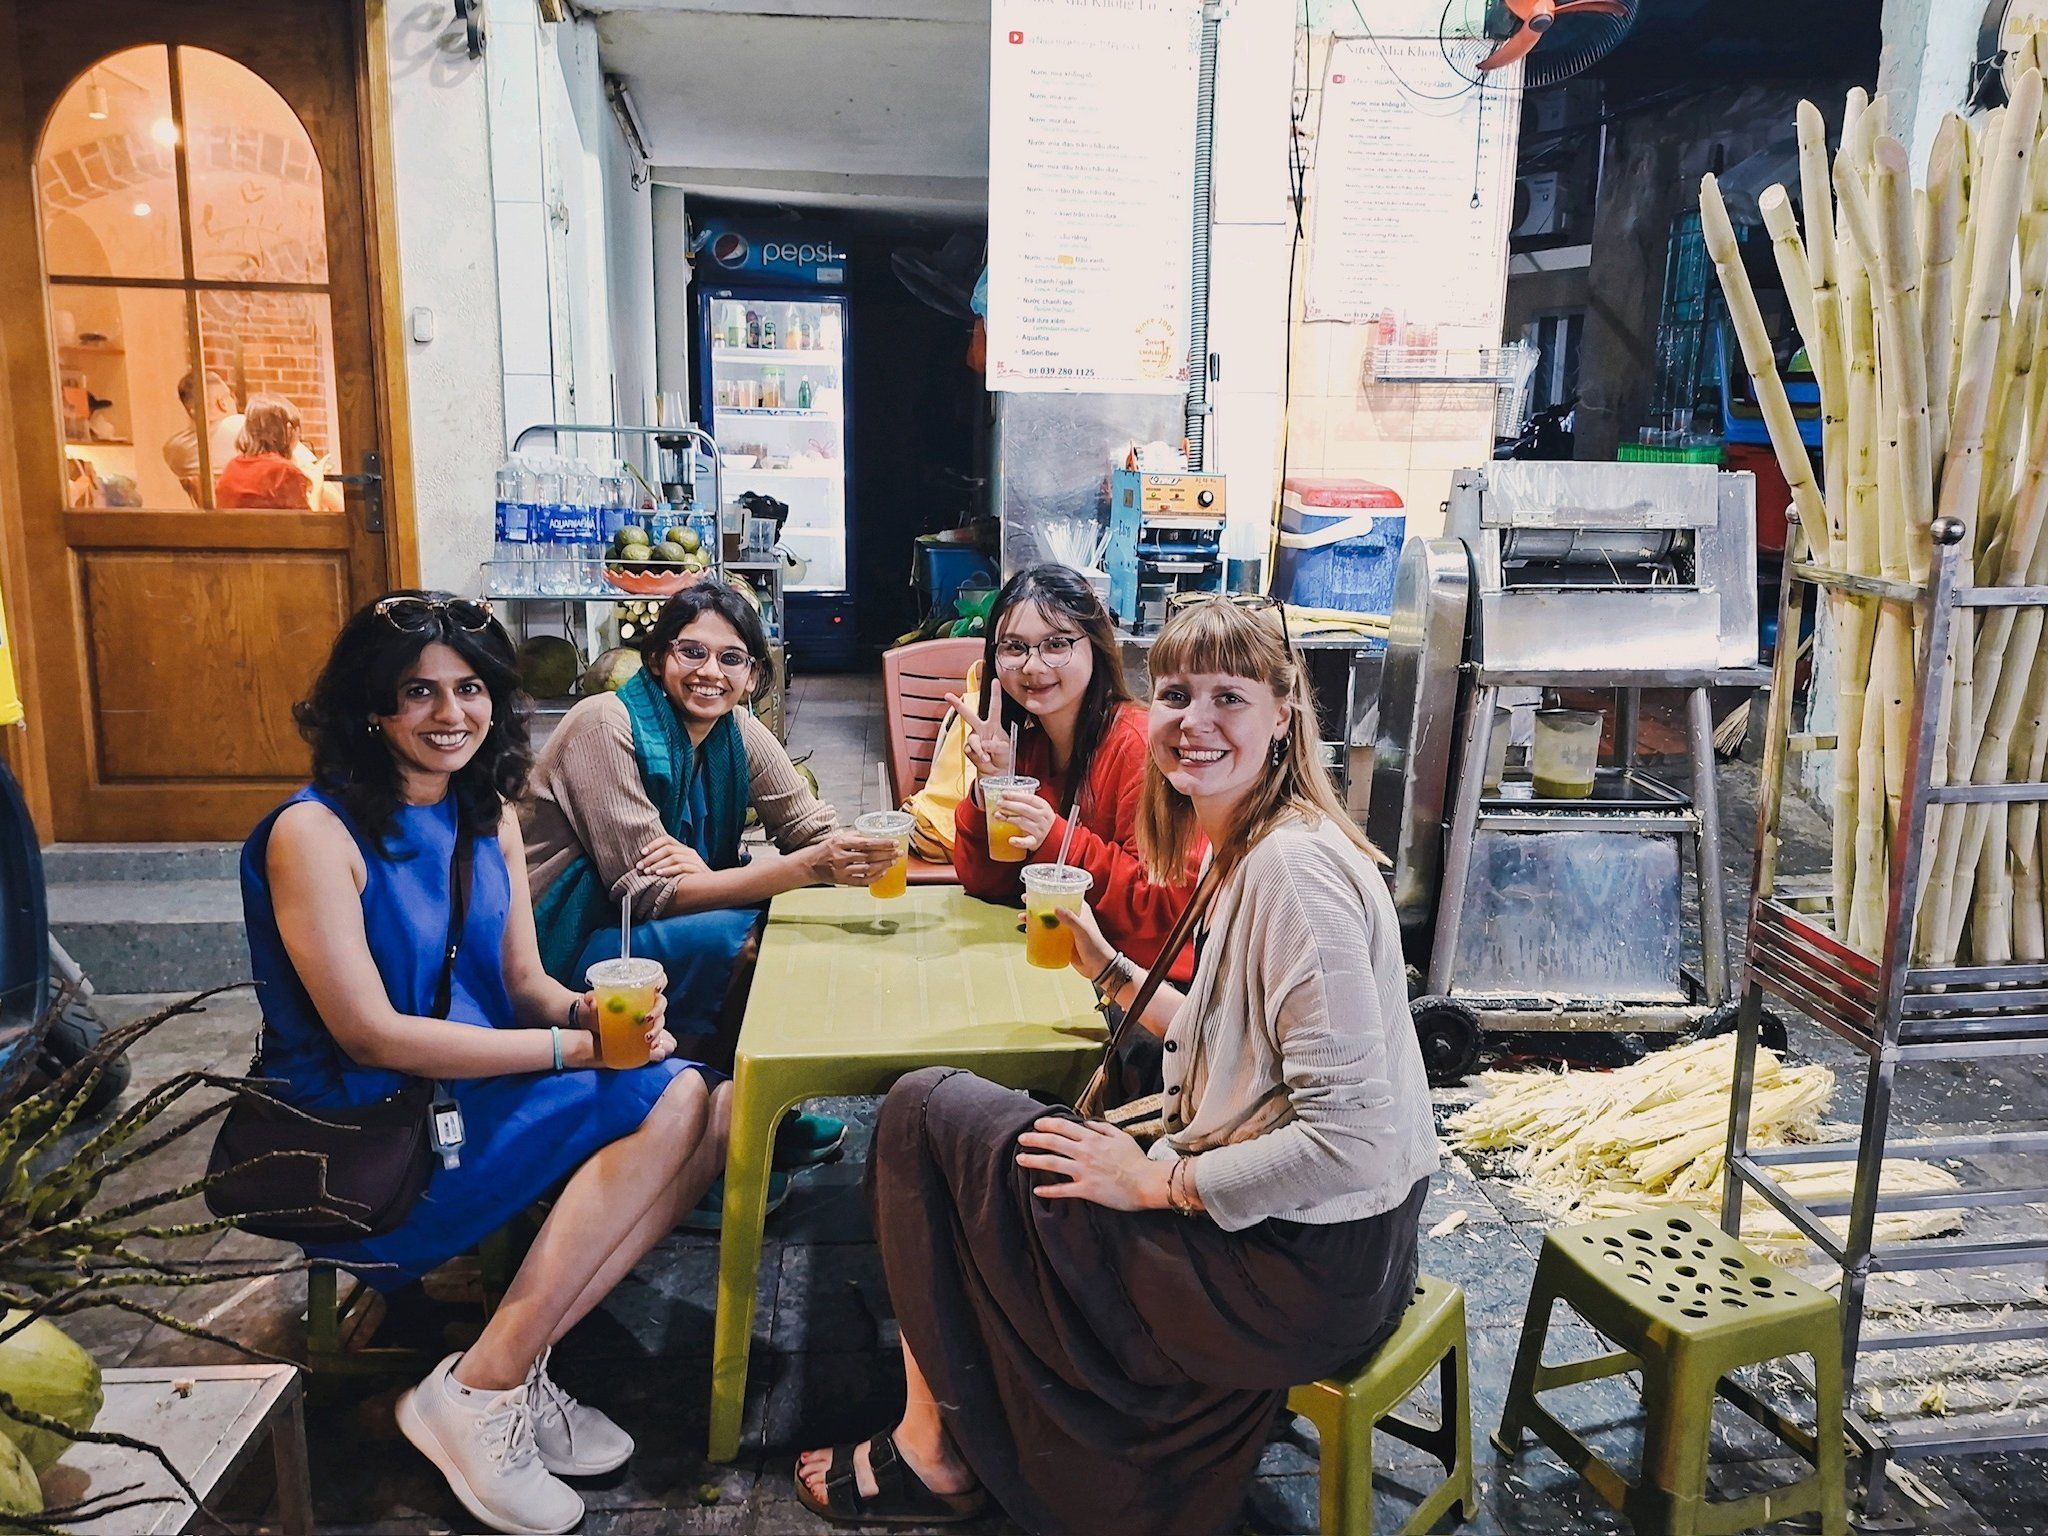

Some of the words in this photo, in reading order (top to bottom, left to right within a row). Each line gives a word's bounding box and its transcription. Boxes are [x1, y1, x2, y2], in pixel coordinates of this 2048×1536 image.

[763, 241, 832, 267] pepsi
[1040, 367, 1056, 375] 039
[1057, 367, 1073, 376] 280
[1075, 368, 1095, 377] 1125
